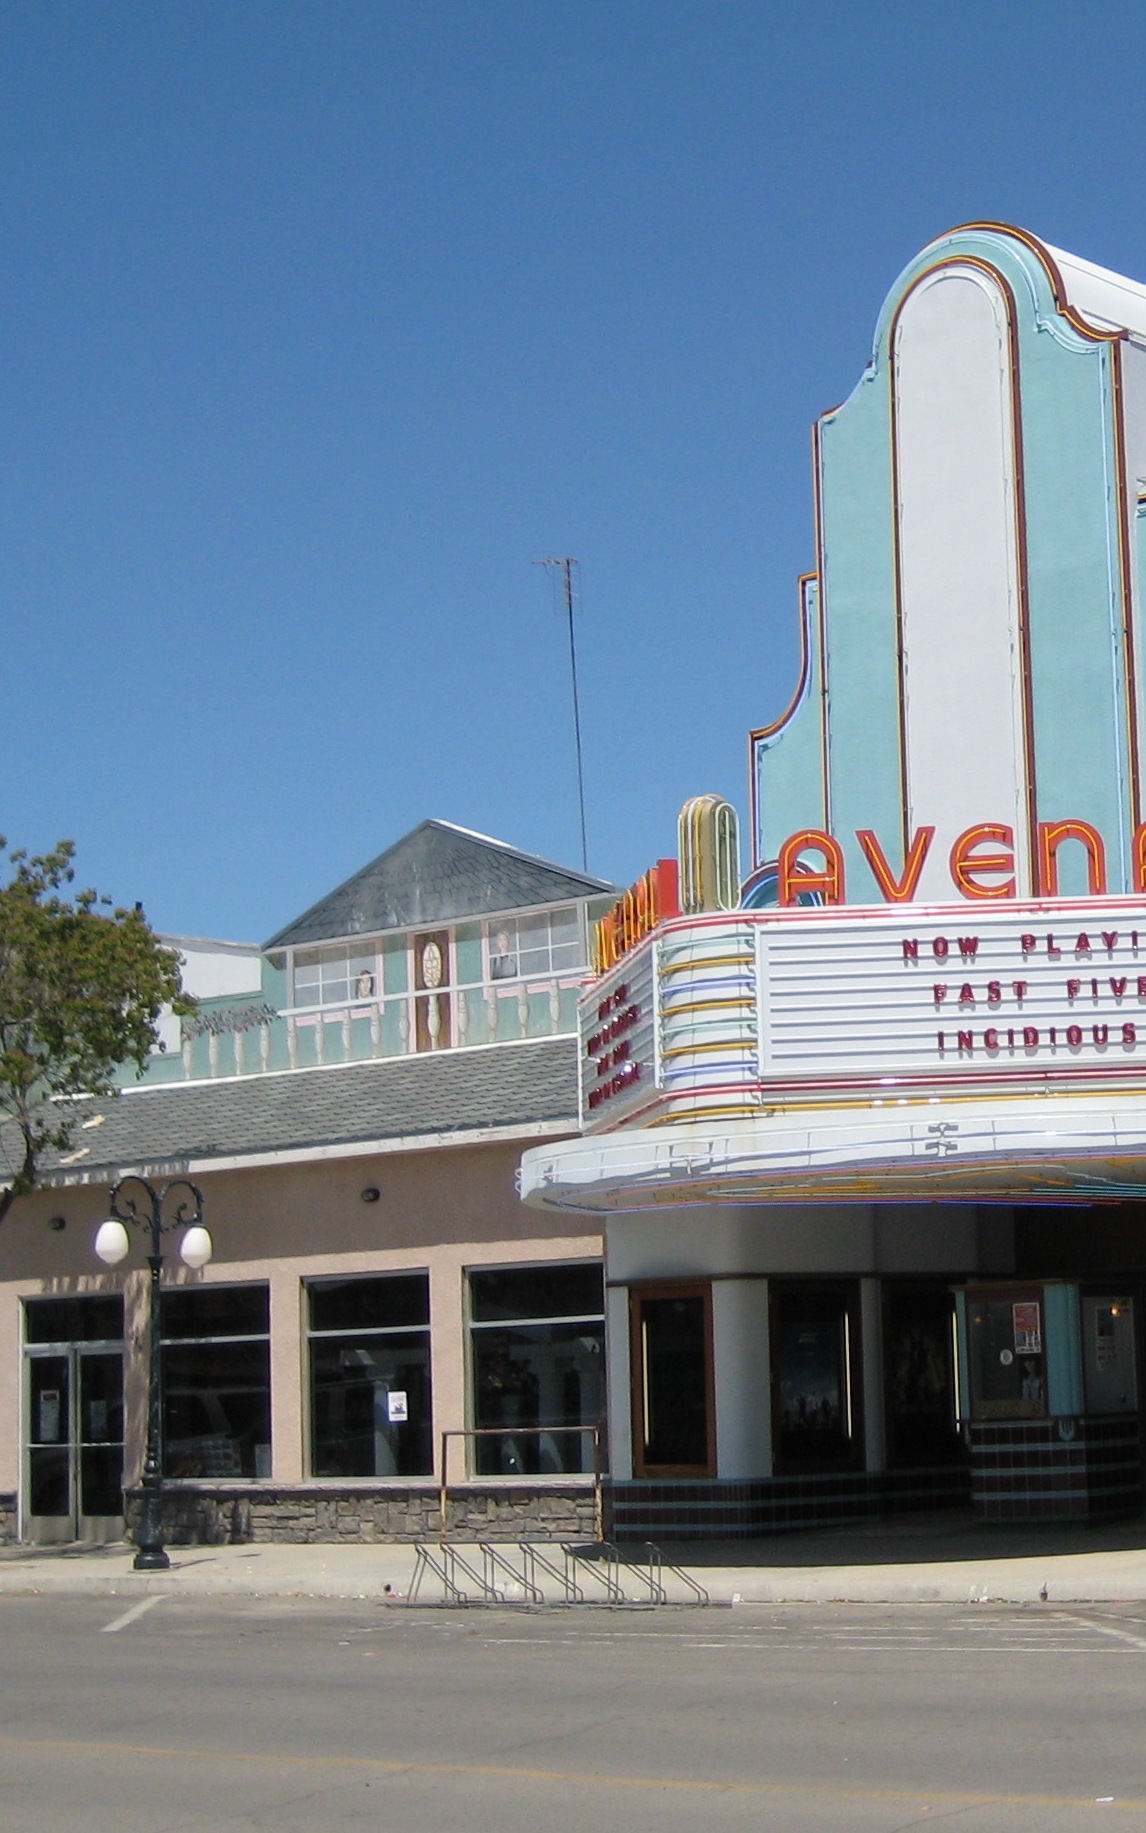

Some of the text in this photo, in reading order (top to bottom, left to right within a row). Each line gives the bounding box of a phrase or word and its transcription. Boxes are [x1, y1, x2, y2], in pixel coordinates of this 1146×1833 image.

[902, 936, 979, 960] NOW
[933, 980, 1028, 1005] FAST
[937, 1022, 1136, 1051] INCIDIOUS
